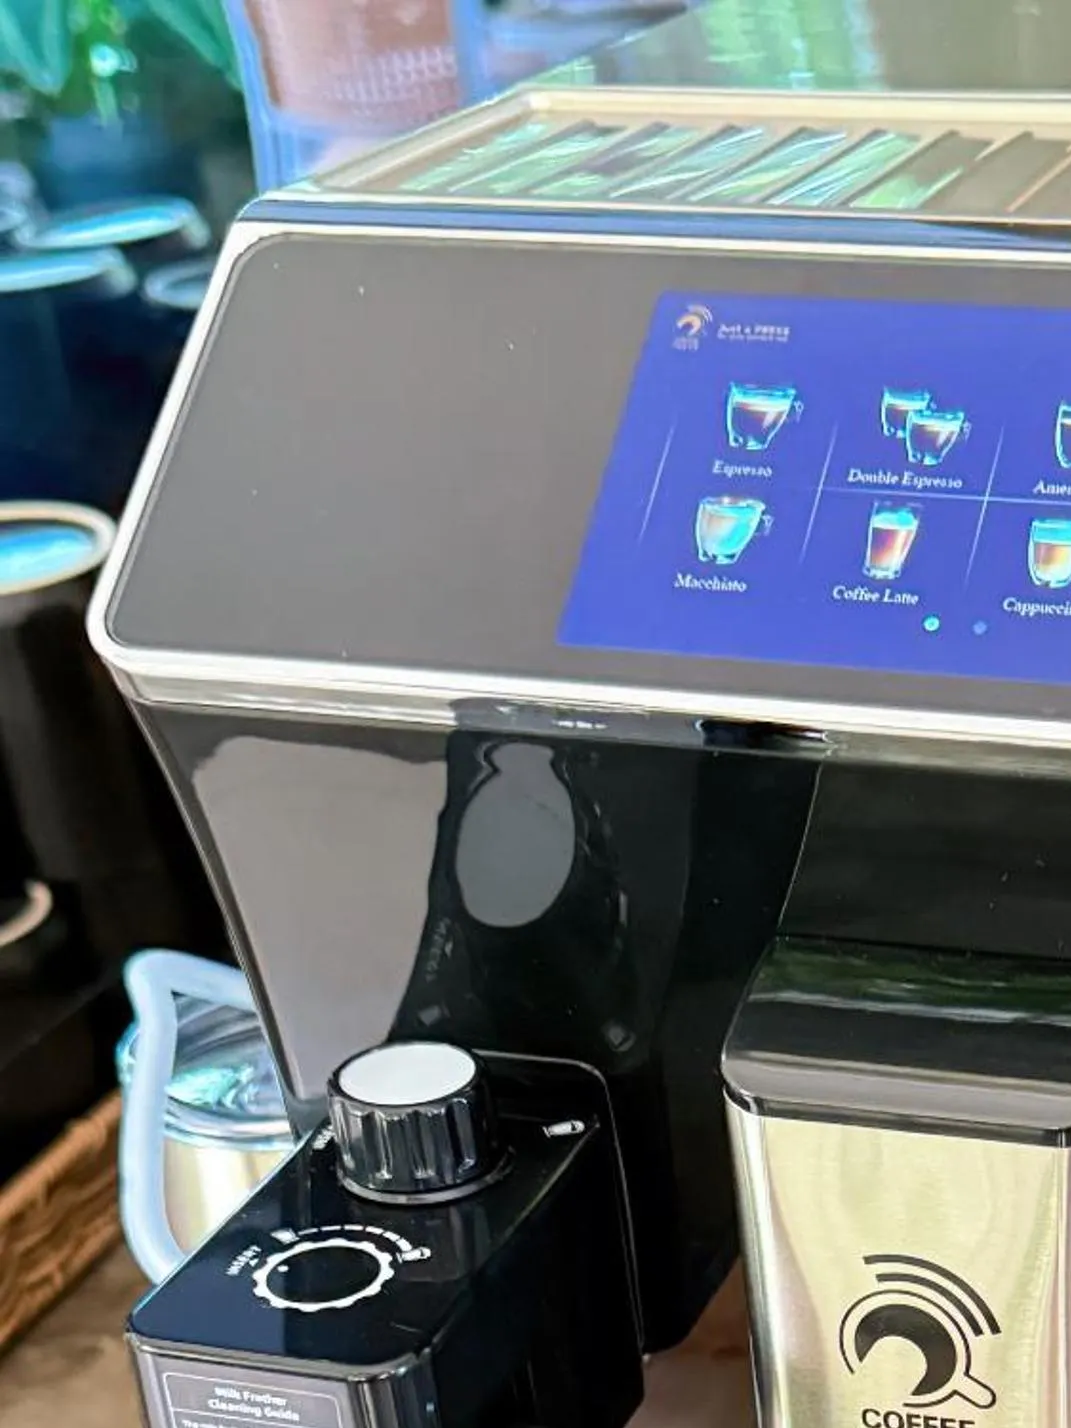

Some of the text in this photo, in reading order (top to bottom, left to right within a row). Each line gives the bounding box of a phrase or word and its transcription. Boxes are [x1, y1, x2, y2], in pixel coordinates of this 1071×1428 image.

[712, 460, 772, 478] Espresso
[848, 468, 963, 490] Double Espresso
[674, 573, 747, 592] Macchiato
[832, 585, 919, 605] Coffee Latte
